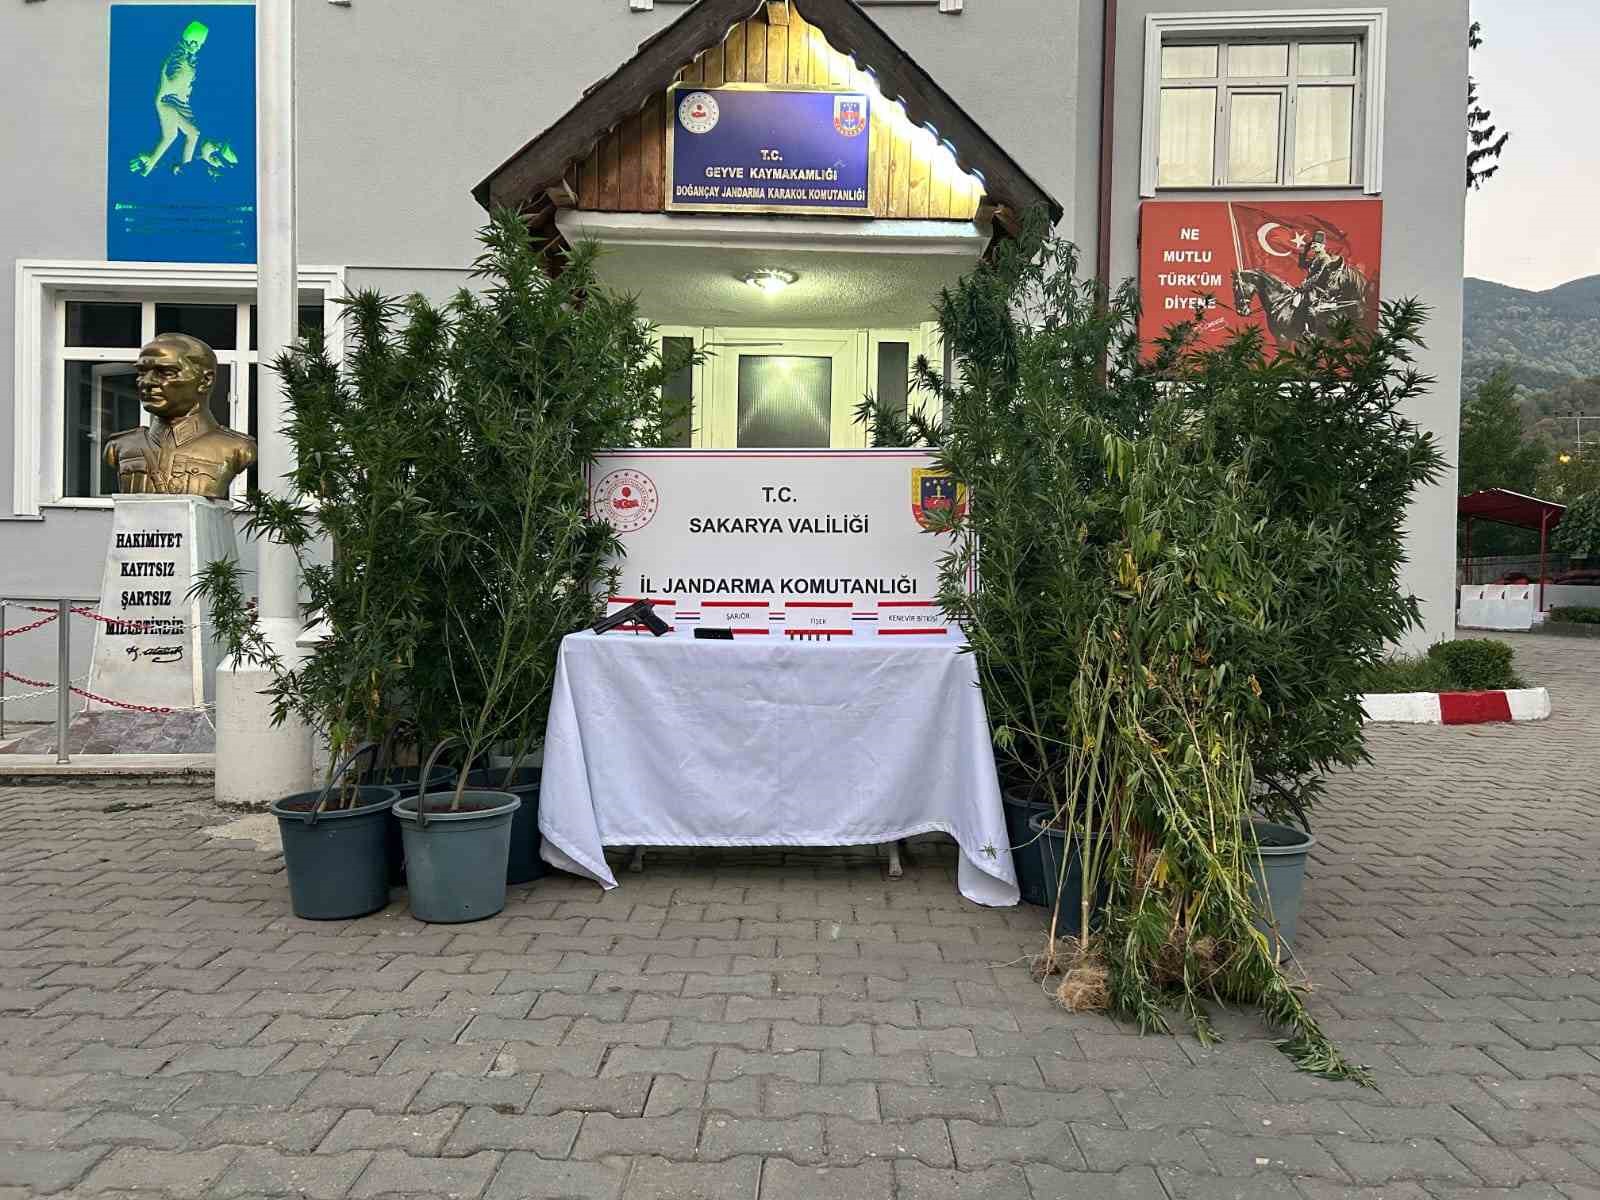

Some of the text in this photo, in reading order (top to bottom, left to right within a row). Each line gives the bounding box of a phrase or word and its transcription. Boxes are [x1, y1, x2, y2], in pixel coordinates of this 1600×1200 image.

[760, 149, 783, 161] T.C.
[705, 166, 838, 181] GEYVE KAYMAKAMLIĞI
[676, 185, 865, 201] DOĞANÇAY JANDARMA KARAKOL KOMUTANLIĞI
[1180, 228, 1200, 241] NE
[1163, 250, 1212, 263] MUTLU
[1158, 273, 1222, 287] TÜRK'ÜM
[761, 486, 797, 503] T.C.
[689, 514, 869, 534] SAKARYA VALİLİĞİ
[116, 529, 183, 548] HAKİMİYET
[120, 562, 175, 577] KAYITSIZ
[640, 574, 918, 594] İL JANDARMA KOMUTANLIĞI
[121, 590, 172, 610] ŞARTSIZ
